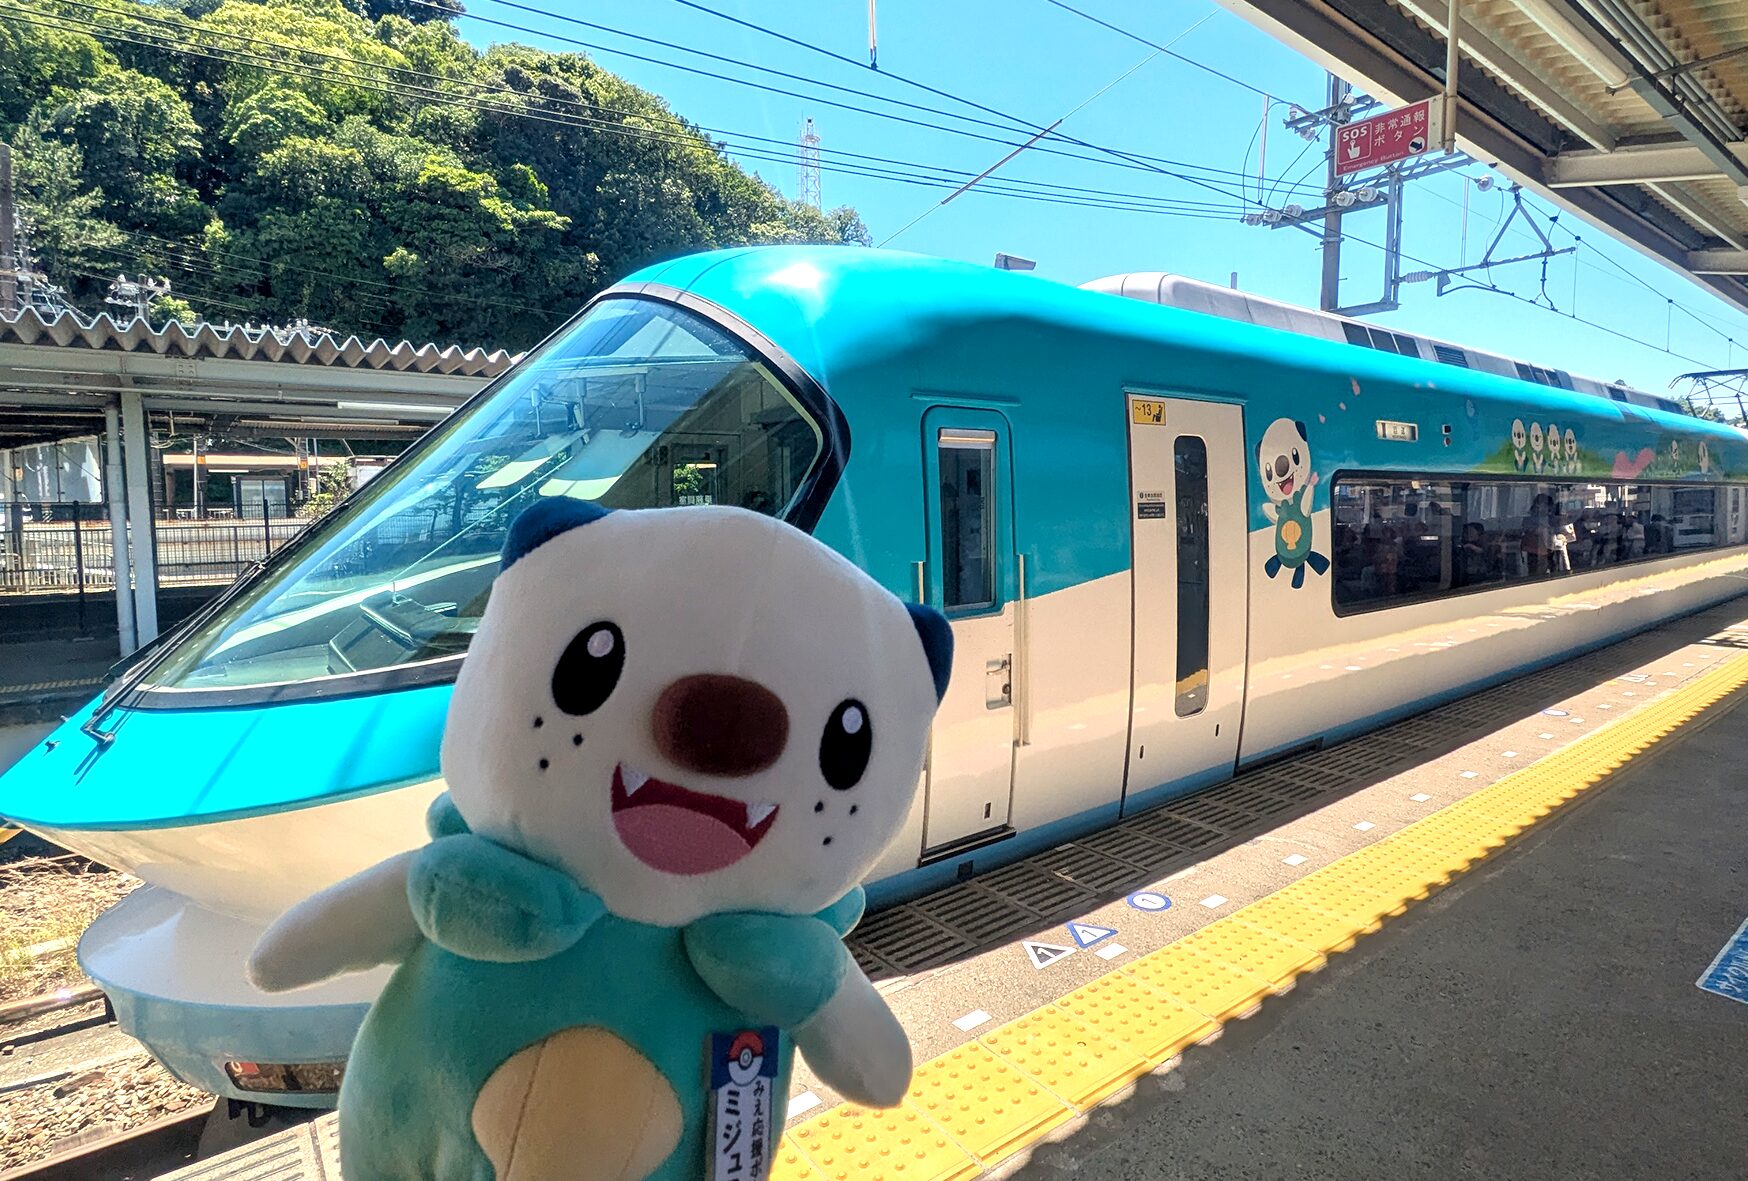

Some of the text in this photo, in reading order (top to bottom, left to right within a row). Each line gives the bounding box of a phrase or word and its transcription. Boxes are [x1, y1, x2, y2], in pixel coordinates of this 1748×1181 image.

[1375, 109, 1425, 135] 非常通報
[1342, 126, 1368, 142] SOS
[1374, 126, 1425, 147] ボタン
[1343, 151, 1404, 172] Emergency Button
[723, 1089, 743, 1181] ミジュ
[750, 1080, 765, 1181] みえ応援ポ
